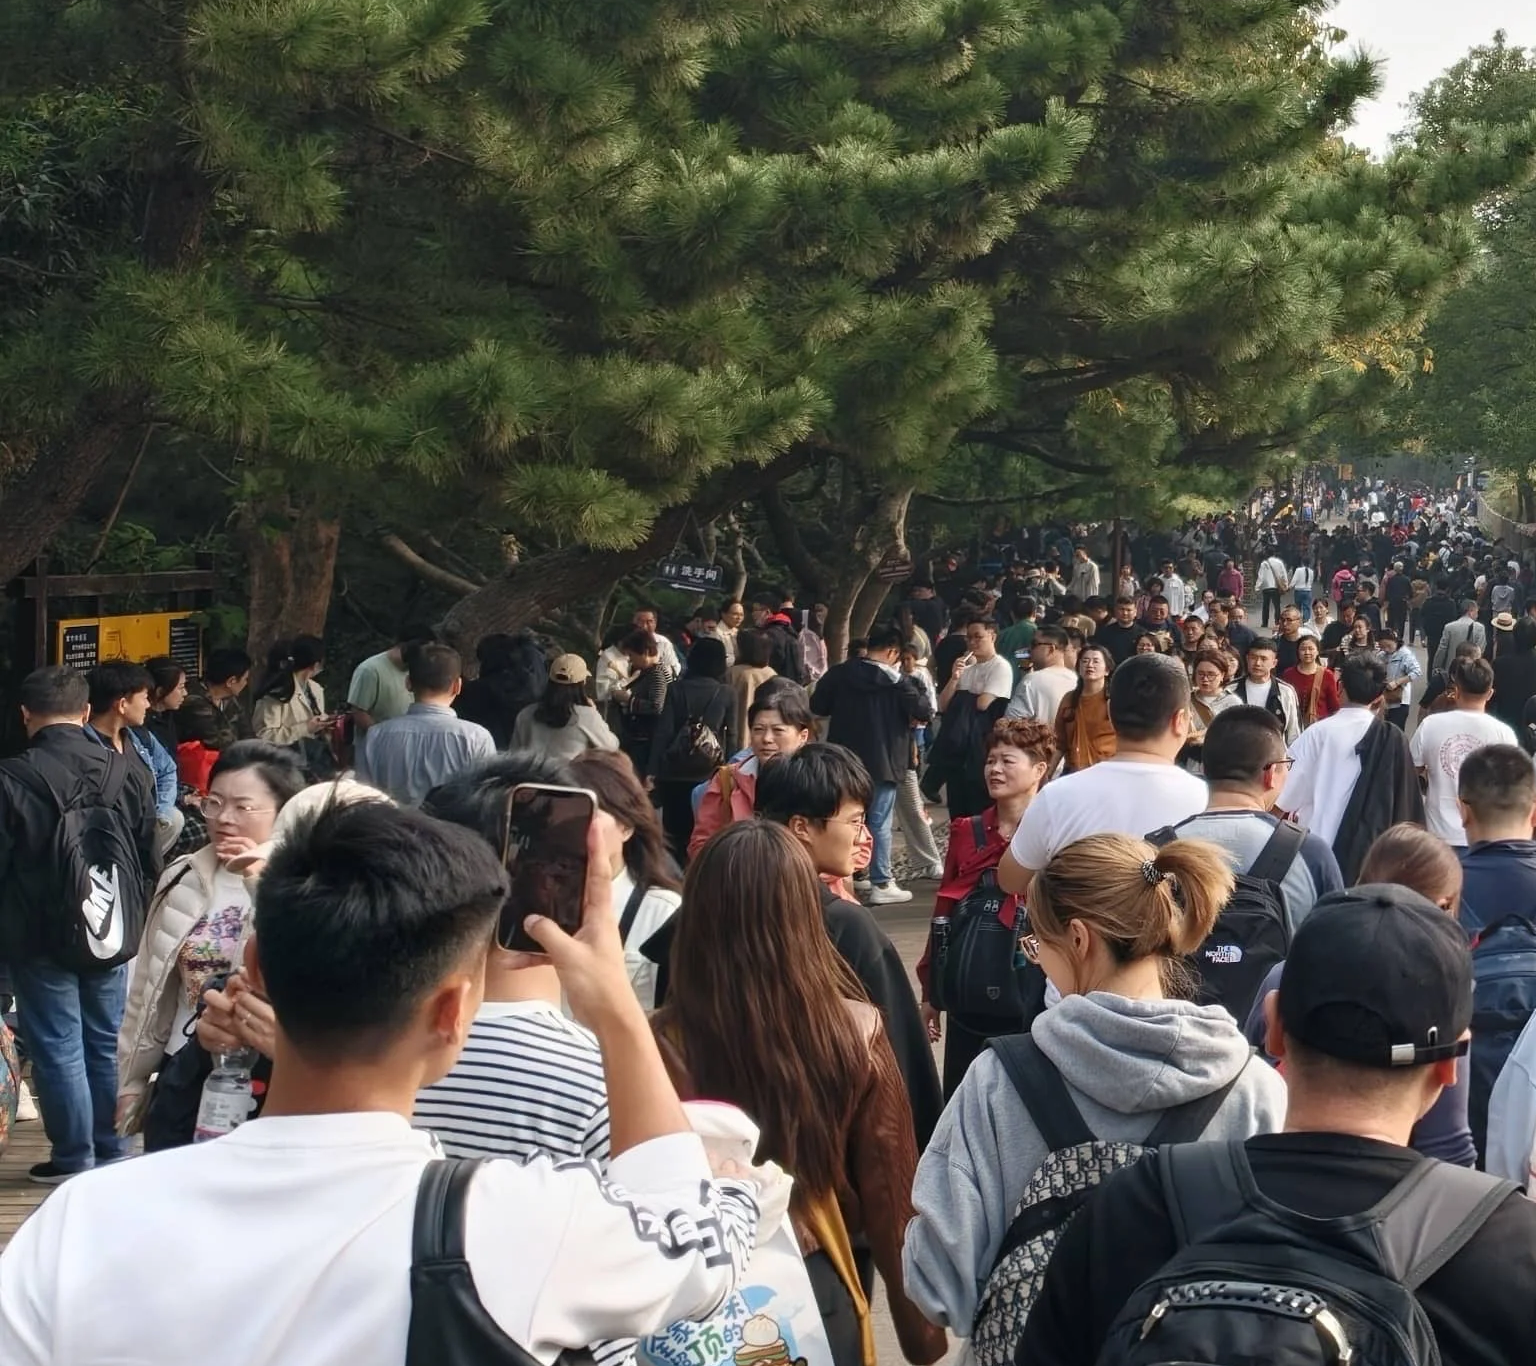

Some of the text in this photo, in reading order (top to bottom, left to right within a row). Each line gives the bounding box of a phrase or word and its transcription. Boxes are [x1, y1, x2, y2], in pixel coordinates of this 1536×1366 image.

[681, 565, 718, 581] 洗手间
[1216, 945, 1231, 953] THE
[1205, 950, 1232, 958] NORTH
[1212, 956, 1231, 964] FACE
